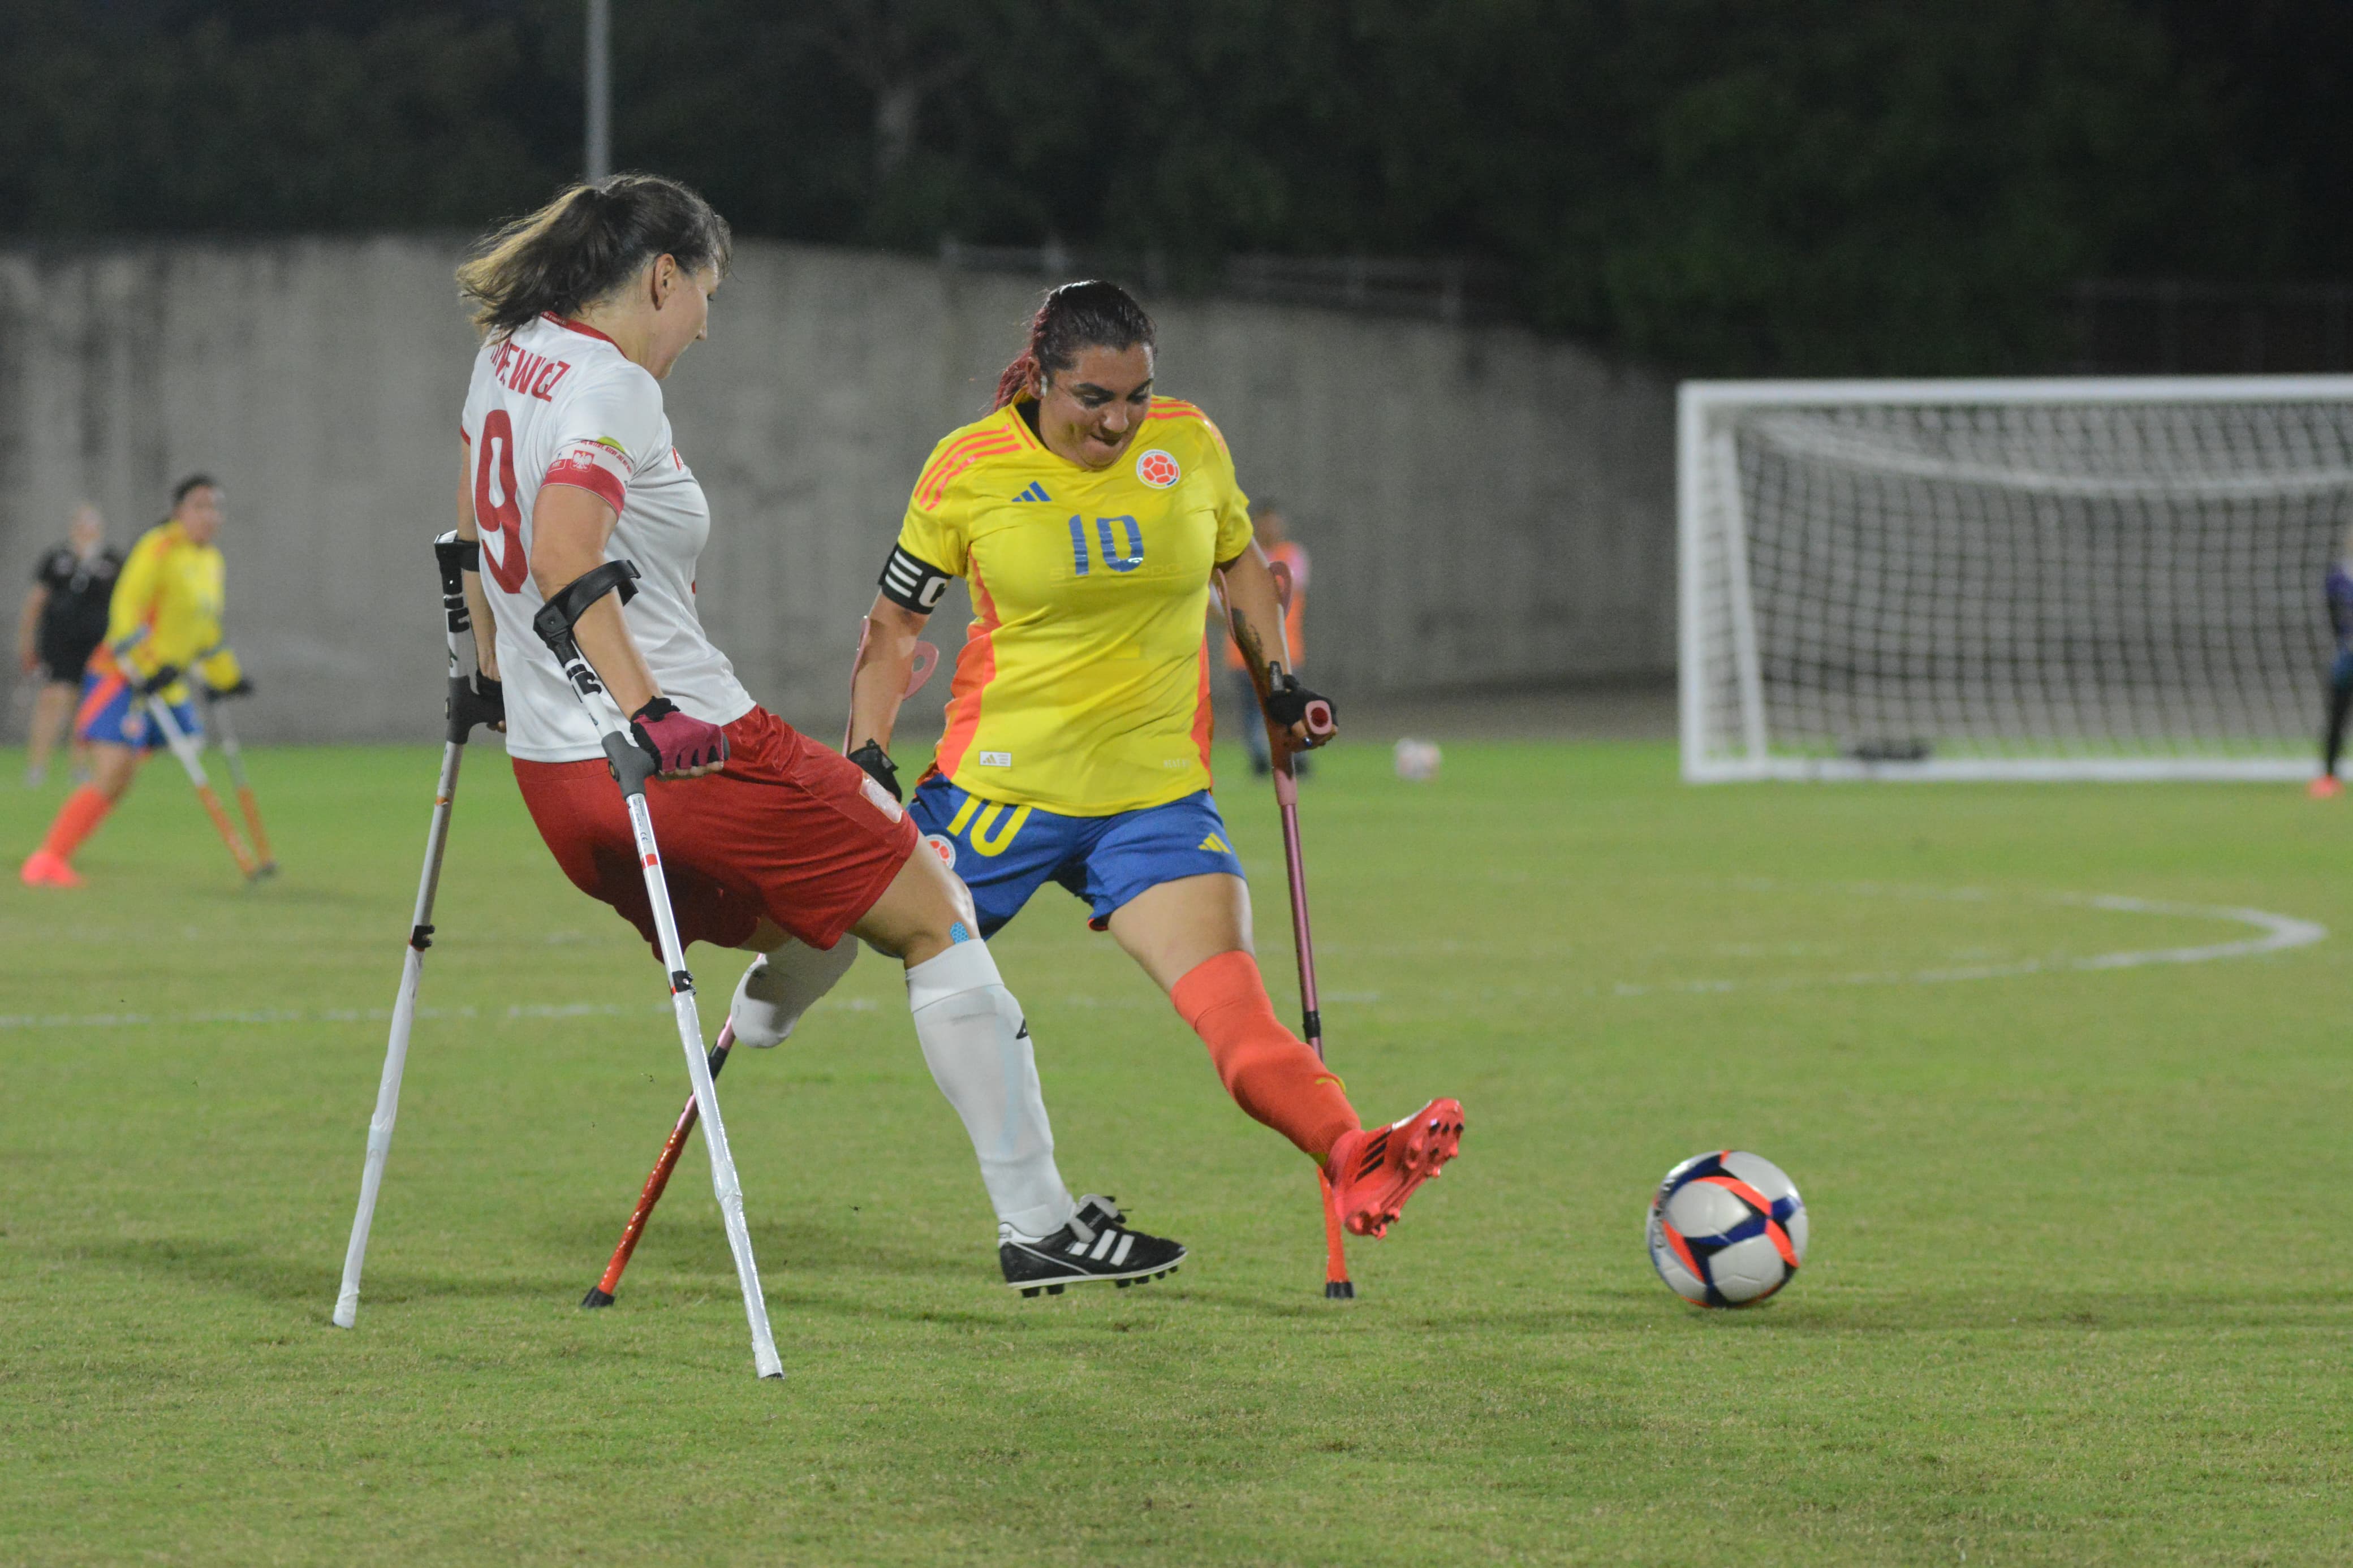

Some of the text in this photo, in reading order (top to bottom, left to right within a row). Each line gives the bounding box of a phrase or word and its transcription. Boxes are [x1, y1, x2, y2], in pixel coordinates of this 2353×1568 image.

[476, 409, 528, 594] 9
[1068, 515, 1144, 576] 10
[947, 794, 1032, 857] 10
